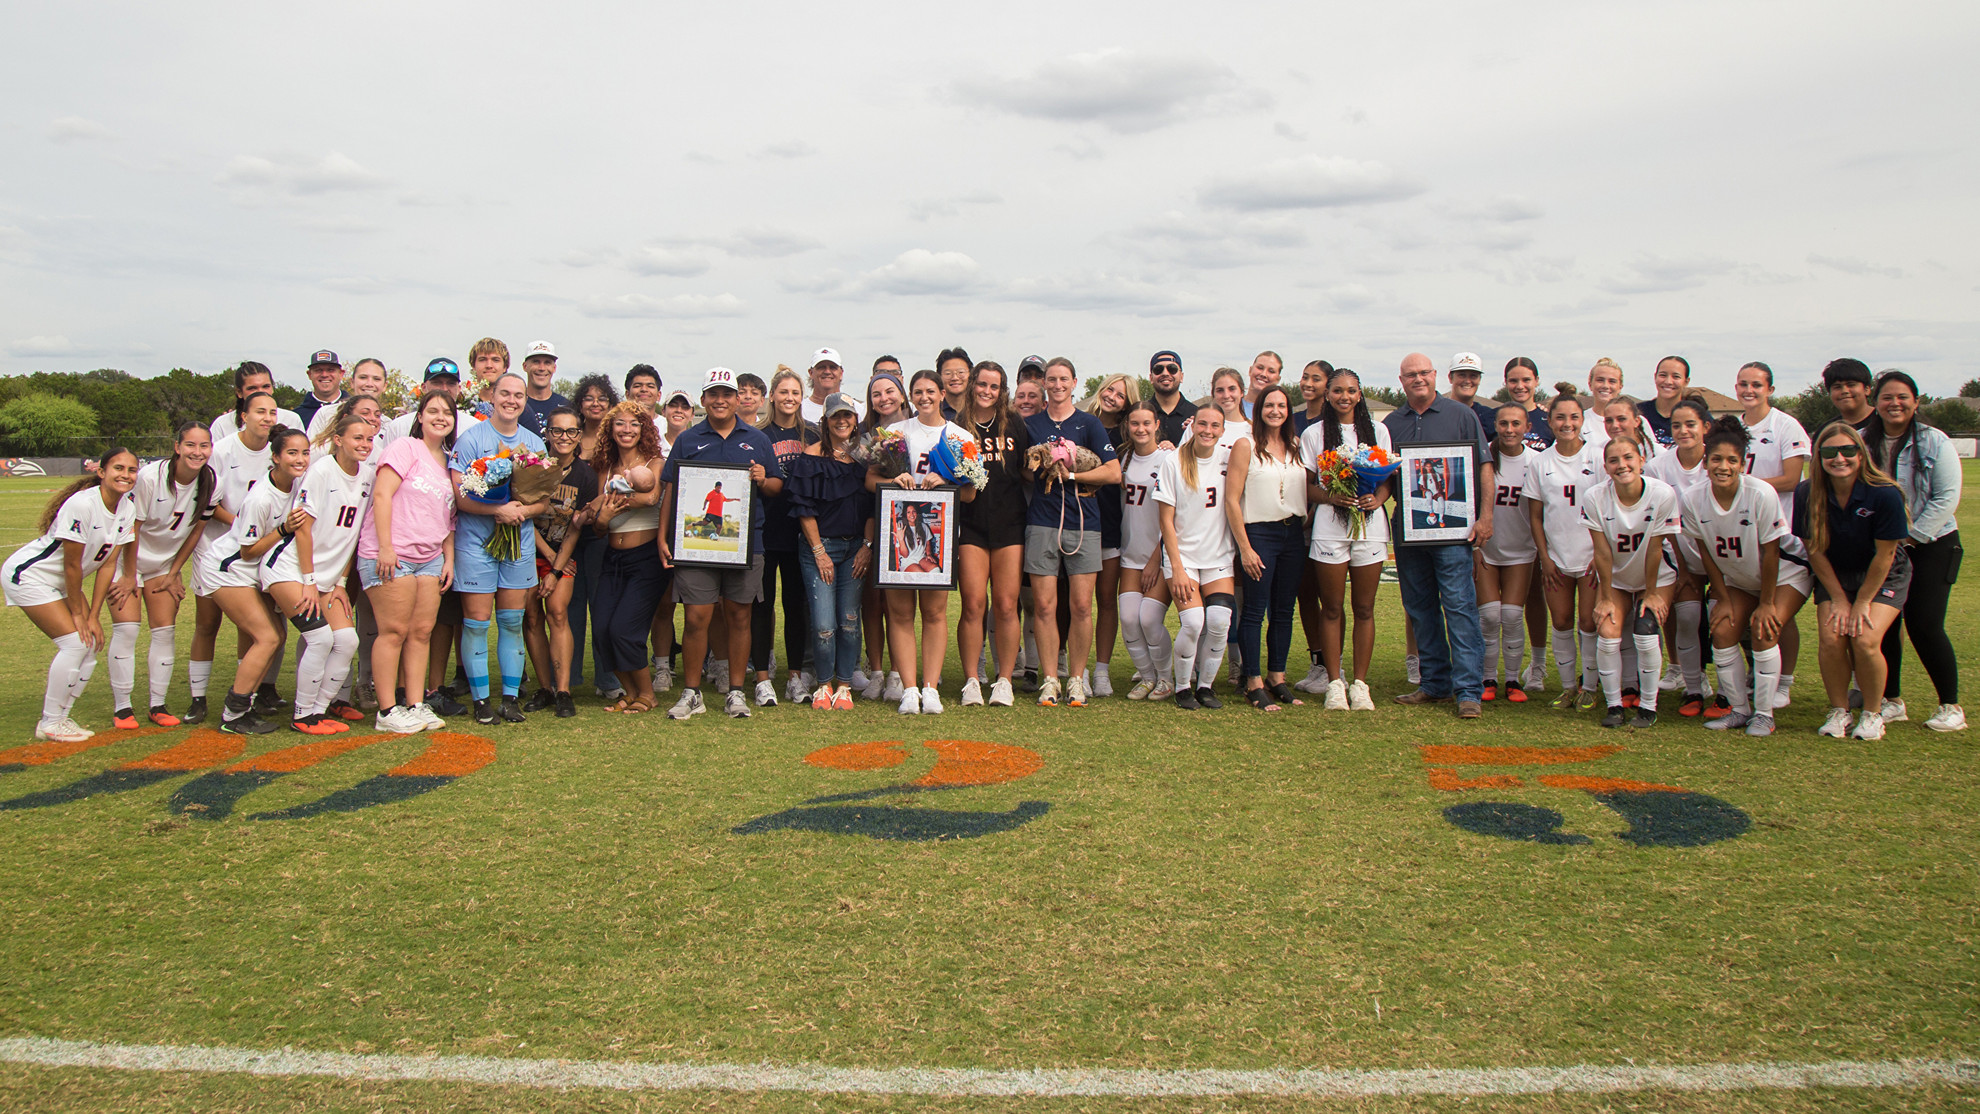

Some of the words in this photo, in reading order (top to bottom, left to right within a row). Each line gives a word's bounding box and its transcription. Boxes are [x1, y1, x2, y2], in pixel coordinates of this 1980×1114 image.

[710, 371, 730, 382] 210
[916, 453, 929, 474] 2
[1126, 484, 1147, 506] 27
[1206, 487, 1217, 508] 3
[1496, 485, 1522, 507] 25
[1564, 485, 1575, 506] 4
[170, 512, 184, 530] 7
[336, 505, 357, 528] 18
[94, 543, 112, 561] 6
[1617, 532, 1645, 553] 20
[1716, 536, 1742, 558] 24
[733, 739, 1050, 841] 2
[1420, 744, 1752, 848] 5
